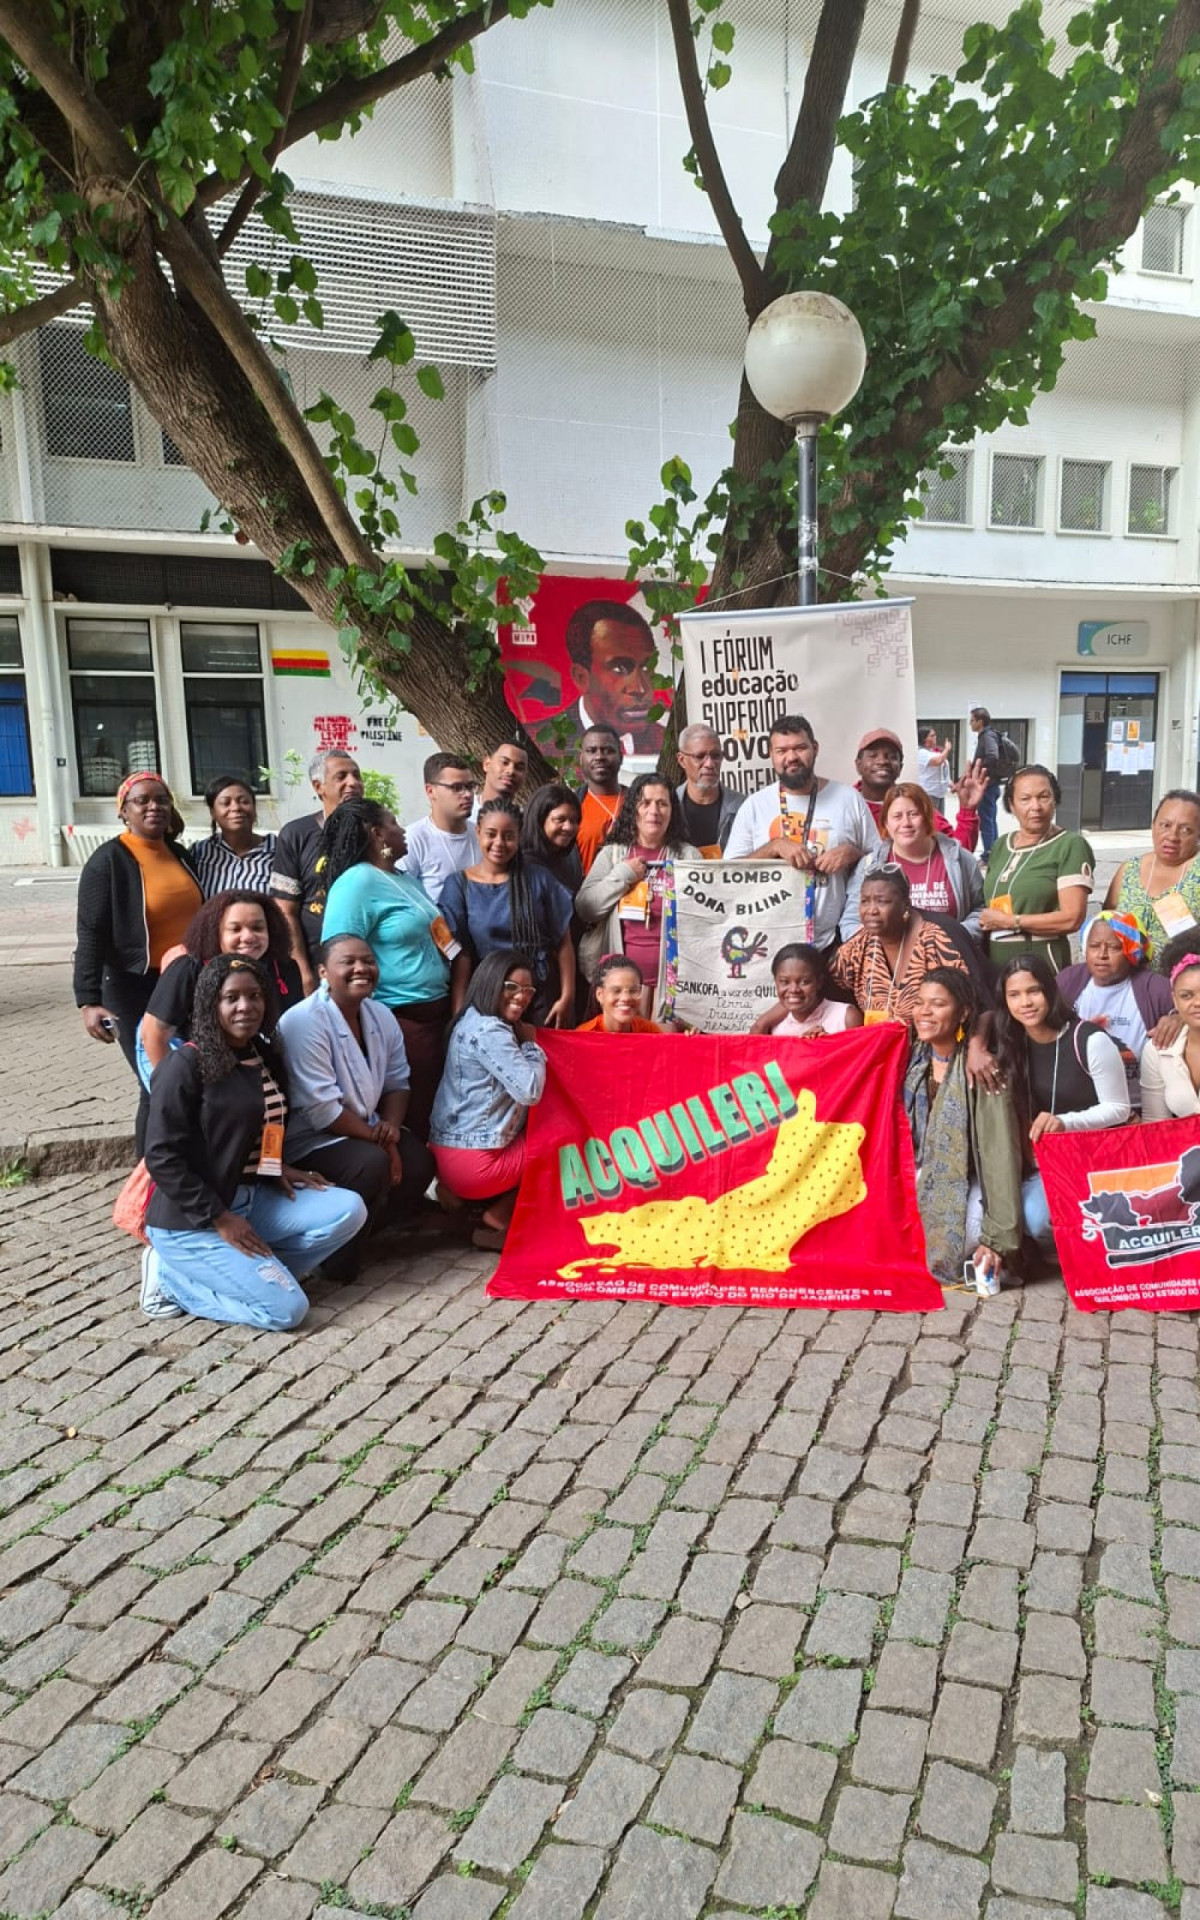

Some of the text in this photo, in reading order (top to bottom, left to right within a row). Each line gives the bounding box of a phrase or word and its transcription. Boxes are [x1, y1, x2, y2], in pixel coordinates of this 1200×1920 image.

[1107, 634, 1133, 646] ICHF
[713, 630, 775, 674] FÓRUM
[701, 669, 799, 700] educação
[360, 730, 402, 742] PALESTINE
[683, 885, 726, 914] DONA
[736, 889, 792, 915] BILINA
[676, 980, 719, 997] SANKOFA
[754, 985, 778, 999] QUIL
[558, 1060, 799, 1207] ACQUILERJ
[1119, 1224, 1200, 1250] ACQUILER
[873, 1289, 892, 1297] DE
[1126, 1283, 1138, 1292] DE
[1142, 1290, 1154, 1299] DO
